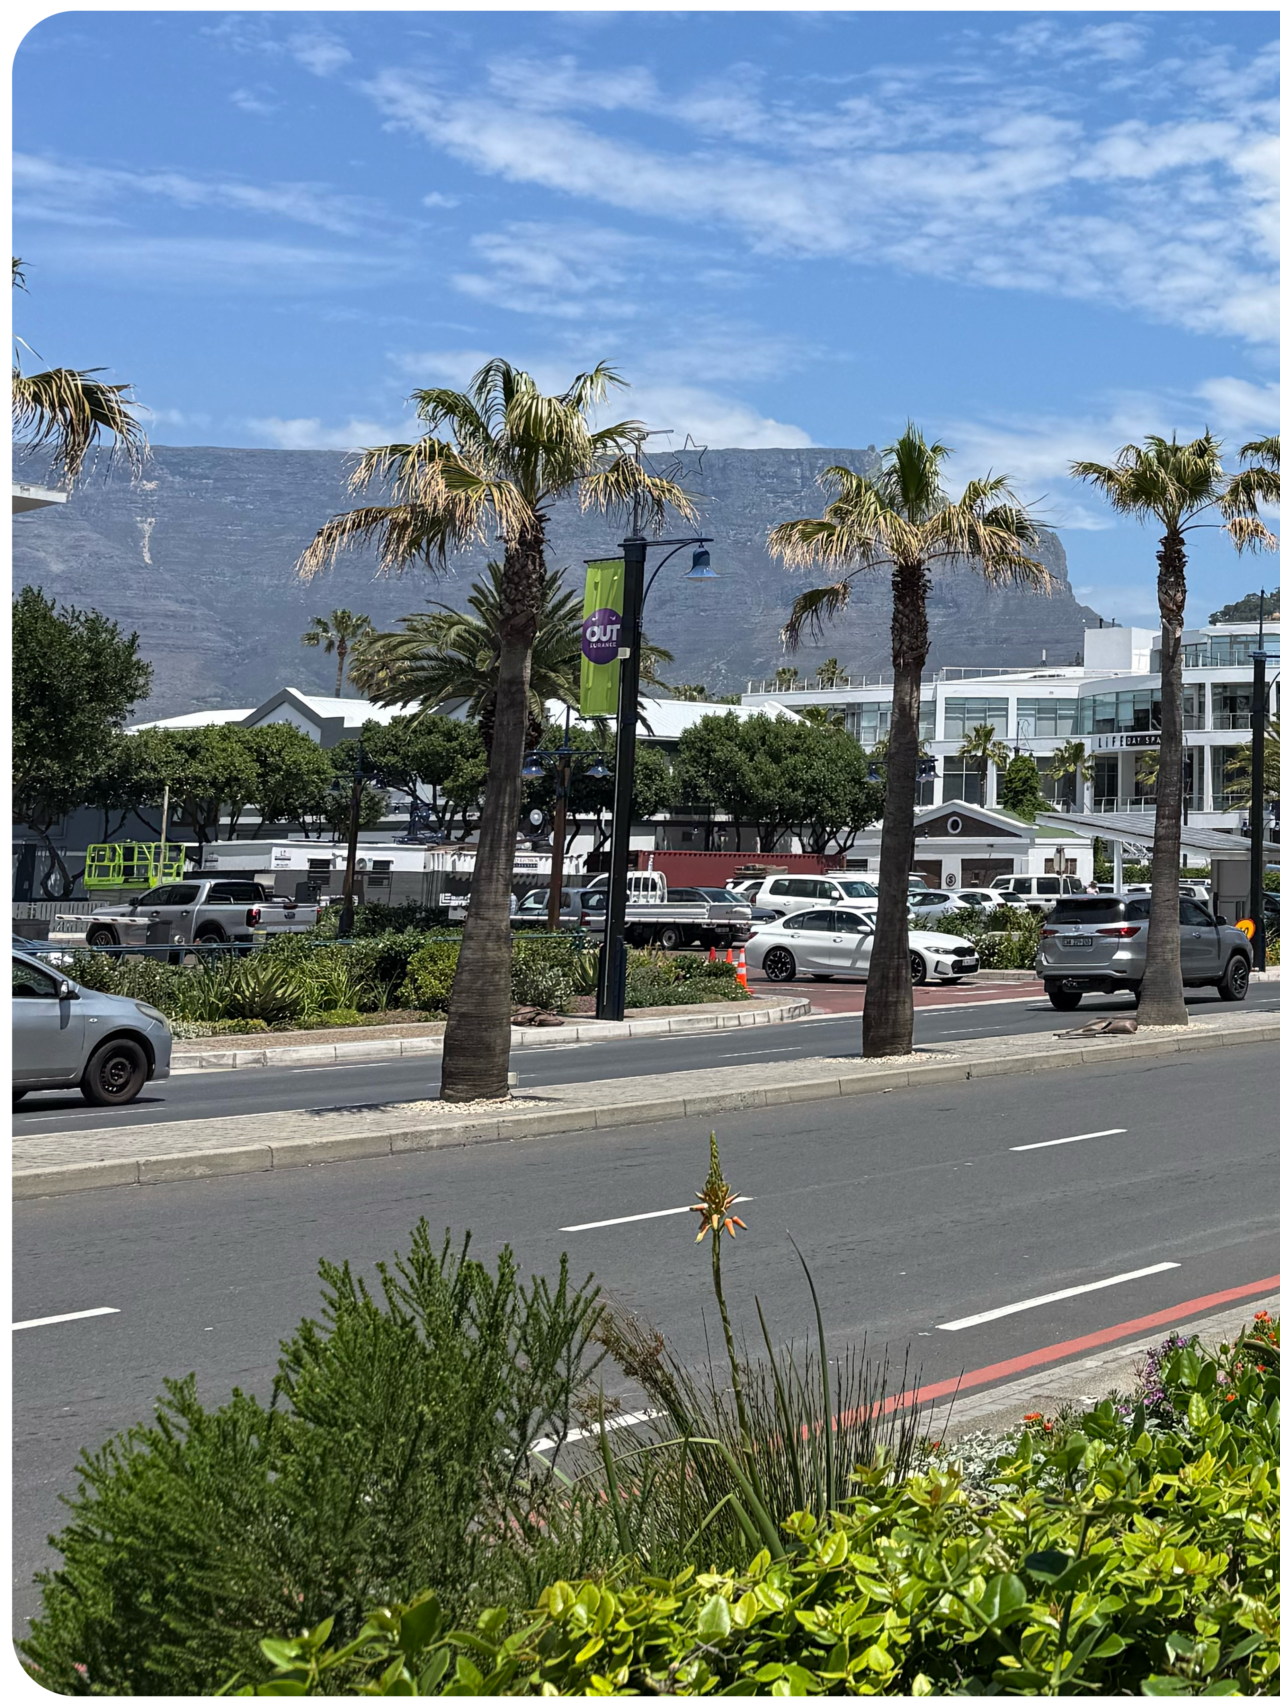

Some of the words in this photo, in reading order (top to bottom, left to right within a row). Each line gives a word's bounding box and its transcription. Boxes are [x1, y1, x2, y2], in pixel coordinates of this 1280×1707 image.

[586, 624, 620, 642] OUT
[1098, 735, 1124, 748] LIFE
[1127, 737, 1141, 745] DAY
[1145, 736, 1161, 744] SPA
